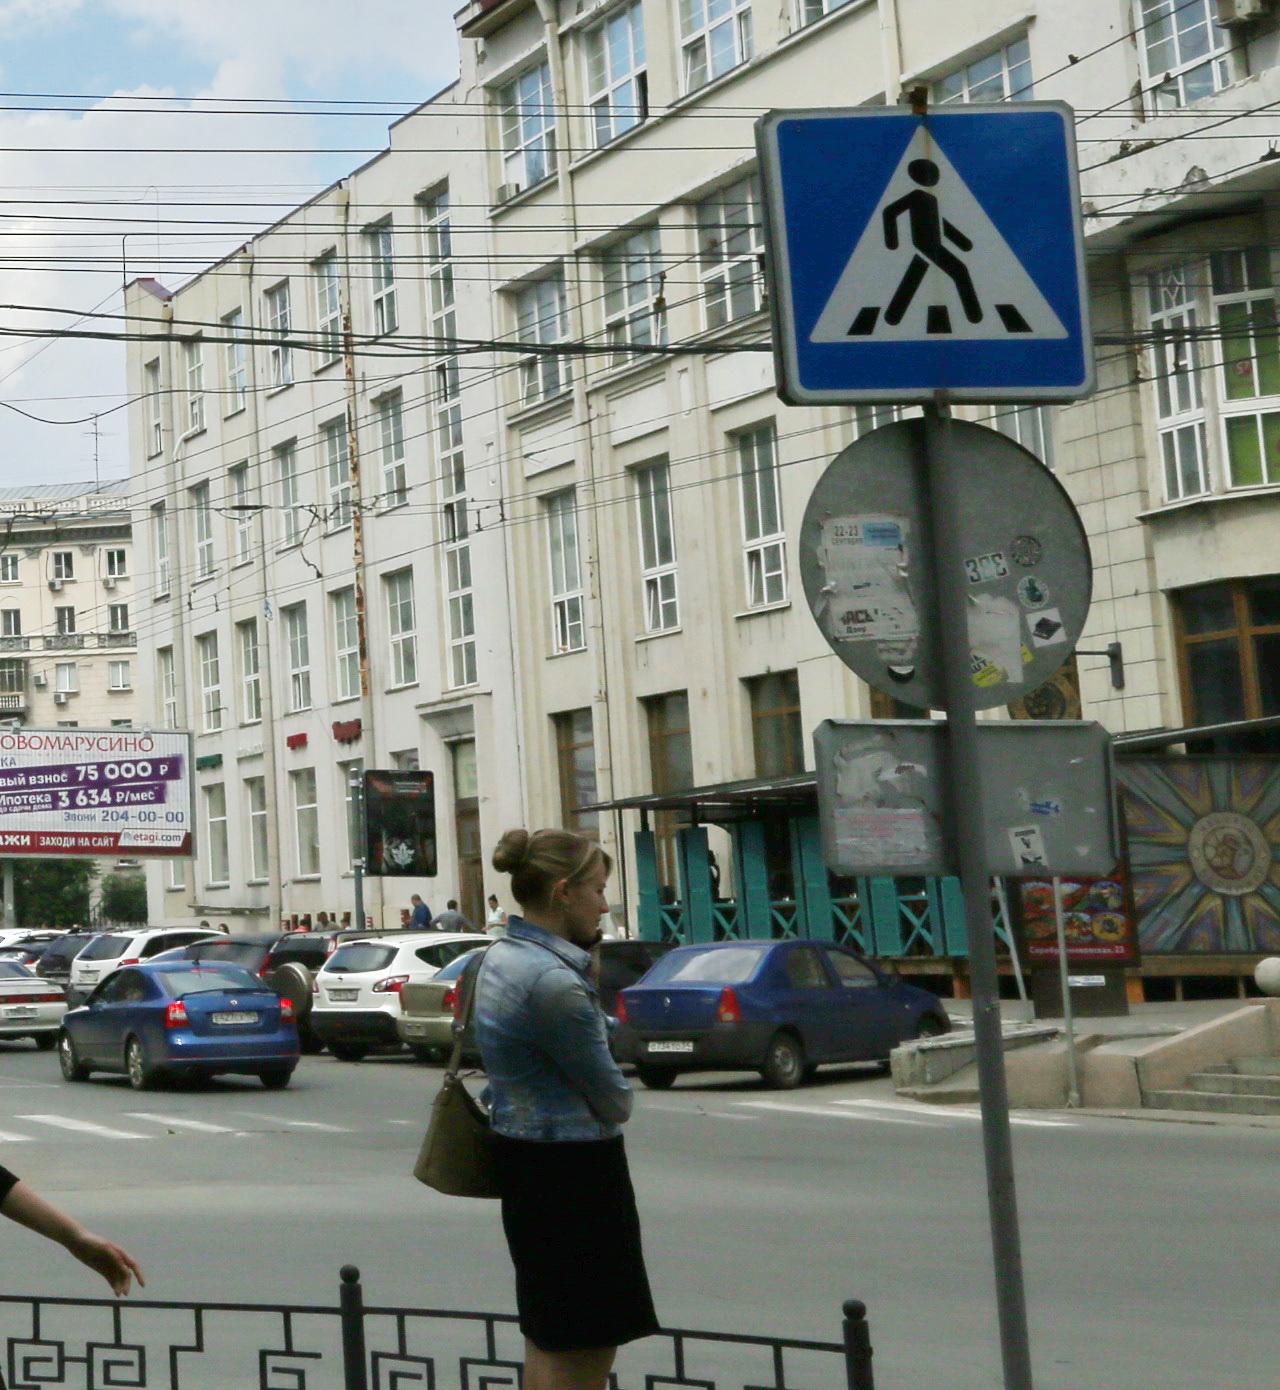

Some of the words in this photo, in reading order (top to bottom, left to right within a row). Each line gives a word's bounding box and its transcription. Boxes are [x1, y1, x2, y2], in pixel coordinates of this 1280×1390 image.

[29, 773, 68, 785] взнос
[75, 765, 99, 781] 75
[104, 761, 153, 780] 000
[58, 791, 70, 808] 3
[76, 788, 112, 806] 634
[101, 810, 185, 823] 204-00-00
[40, 836, 76, 848] ЗАХОДИ
[80, 836, 90, 847] НА
[92, 835, 114, 847] САЙТ
